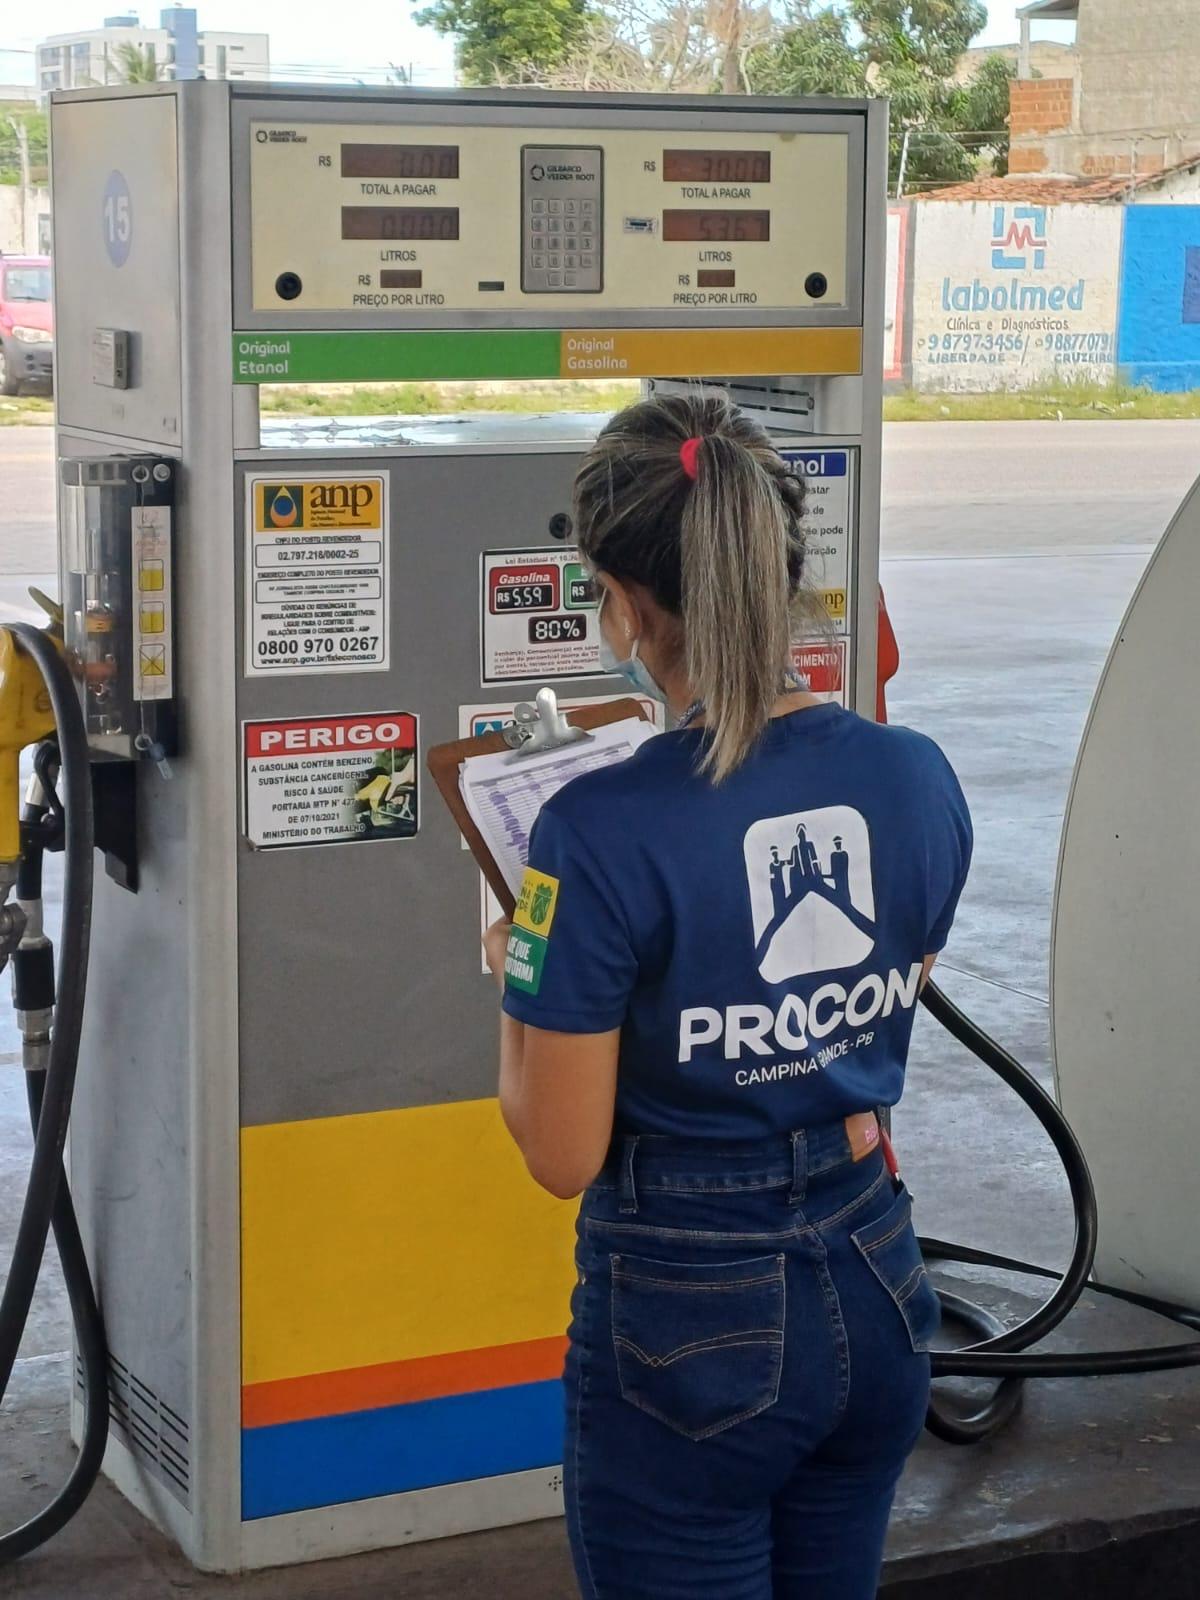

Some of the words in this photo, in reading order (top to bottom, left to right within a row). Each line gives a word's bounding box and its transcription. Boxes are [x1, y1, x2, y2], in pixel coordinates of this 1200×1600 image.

[319, 155, 331, 167] R$
[644, 161, 656, 172] R$
[361, 184, 392, 195] TOTAL
[393, 185, 401, 195] A
[401, 185, 436, 196] PAGAR
[681, 187, 709, 198] TOTAL
[712, 188, 718, 198] A
[719, 188, 751, 198] PAGAR
[104, 196, 130, 243] 15
[380, 250, 416, 261] LITROS
[699, 251, 732, 262] LITROS
[358, 275, 371, 285] R$
[678, 275, 690, 285] R$
[353, 294, 388, 307] PREÇO
[391, 295, 413, 305] POR
[416, 294, 445, 305] LITRO
[673, 293, 705, 306] PREÇO
[708, 294, 728, 304] POR
[730, 293, 757, 304] LITRO
[941, 278, 1085, 311] labolmed
[987, 321, 993, 330] e
[1002, 317, 1069, 333] Diagnósticos
[239, 341, 290, 357] Original
[567, 338, 614, 353] Original
[567, 357, 628, 370] Gasolina
[928, 352, 1006, 364] LIBERDADE
[239, 360, 289, 374] Etanol
[783, 455, 825, 476] anol
[310, 484, 373, 517] anp
[820, 525, 843, 536] pode
[499, 572, 550, 584] Gasolina
[825, 592, 845, 608] np
[535, 619, 581, 640] 80%
[258, 640, 299, 656] 0800
[304, 638, 334, 653] 970
[340, 636, 379, 652] 0267
[260, 722, 401, 751] PERIGO
[259, 762, 299, 772] GASOLINA
[301, 758, 334, 769] CONTÉM
[258, 774, 309, 786] SUBSTÂNCIA
[284, 788, 308, 797] RISCO
[318, 785, 344, 795] SAÚDE
[272, 801, 311, 812] PORTARIA
[313, 800, 329, 809] MTP
[288, 815, 298, 824] DE
[300, 813, 340, 823] 07/10/2021
[310, 827, 321, 835] DO
[324, 823, 367, 835] TRABALHO
[678, 963, 923, 1064] PROCON
[736, 1056, 818, 1086] CAMPINA
[856, 1031, 875, 1048] PB
